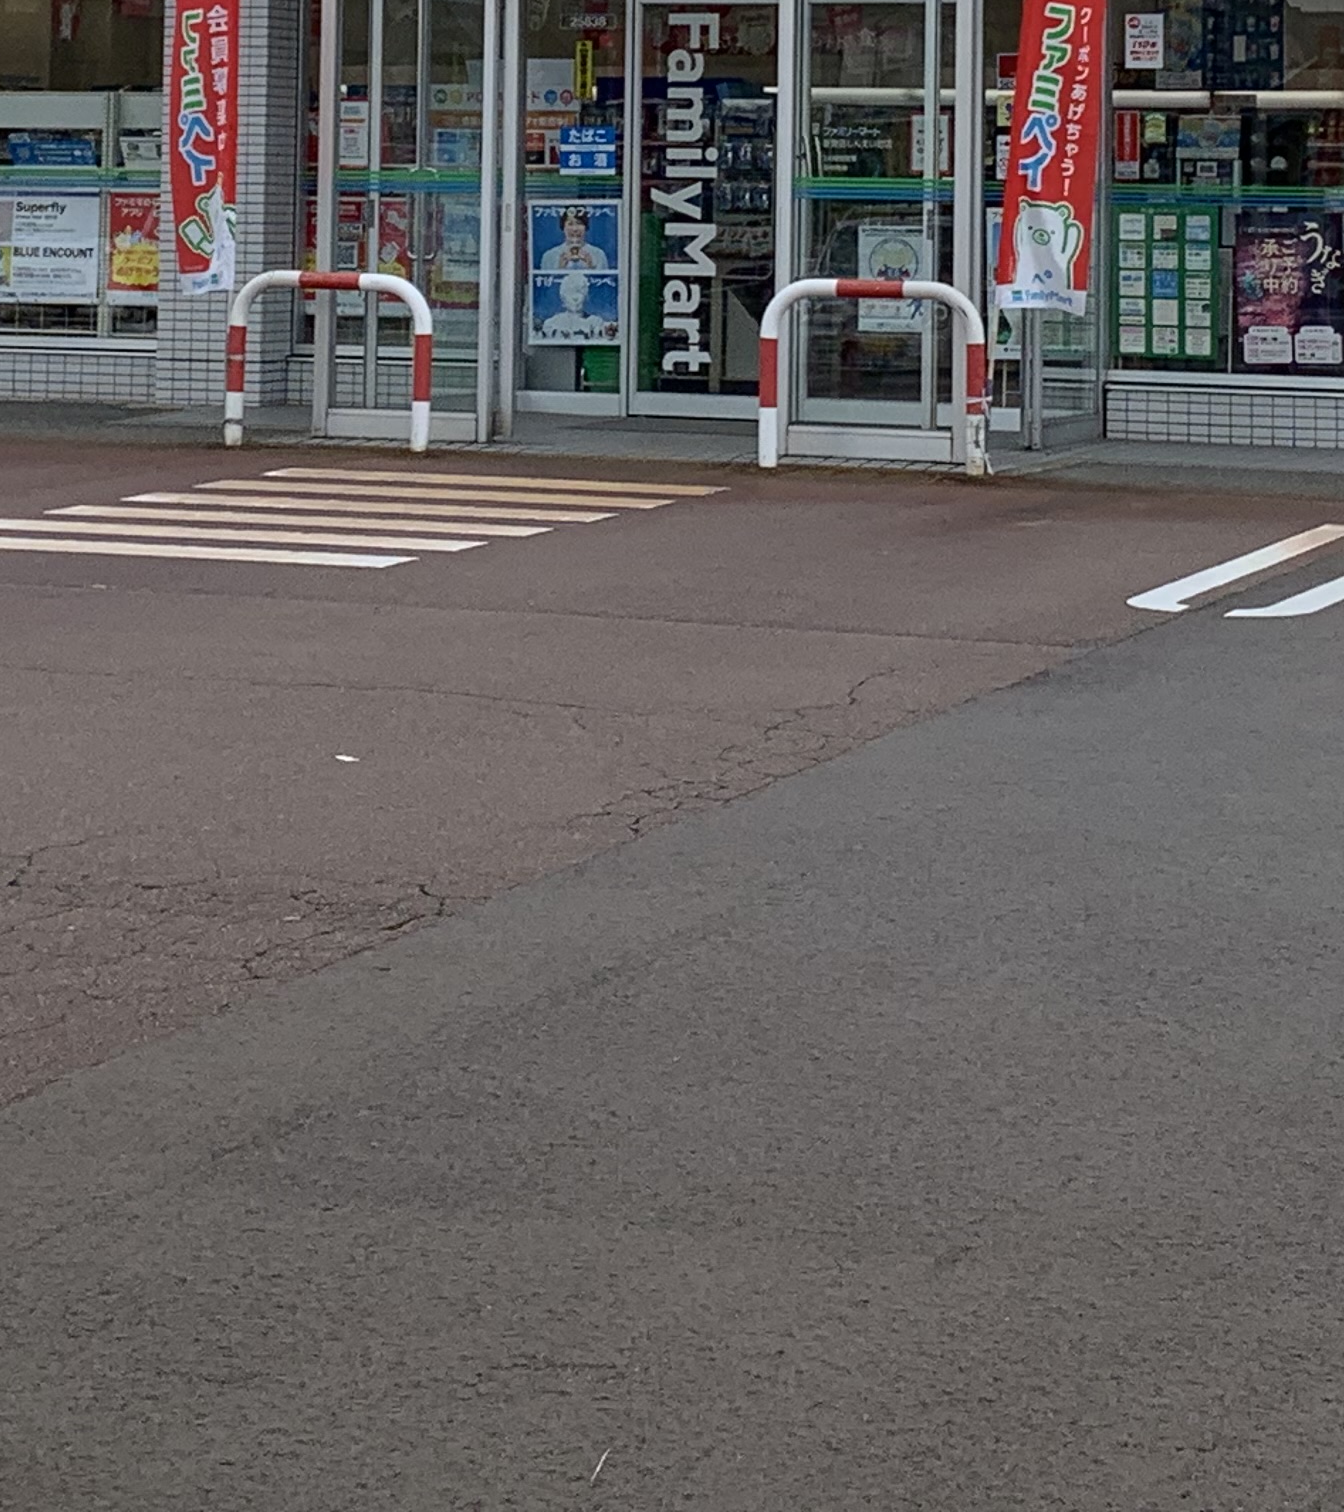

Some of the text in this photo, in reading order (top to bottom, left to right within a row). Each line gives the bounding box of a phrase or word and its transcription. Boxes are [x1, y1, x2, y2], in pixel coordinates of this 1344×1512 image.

[1017, 1, 1076, 193] ファミペイ
[567, 128, 608, 144] たばこ
[15, 201, 67, 215] Superfly
[650, 13, 721, 373] FamilyMart
[12, 246, 95, 259] BLUE ENCOUNT
[1299, 221, 1341, 295] うなぎ
